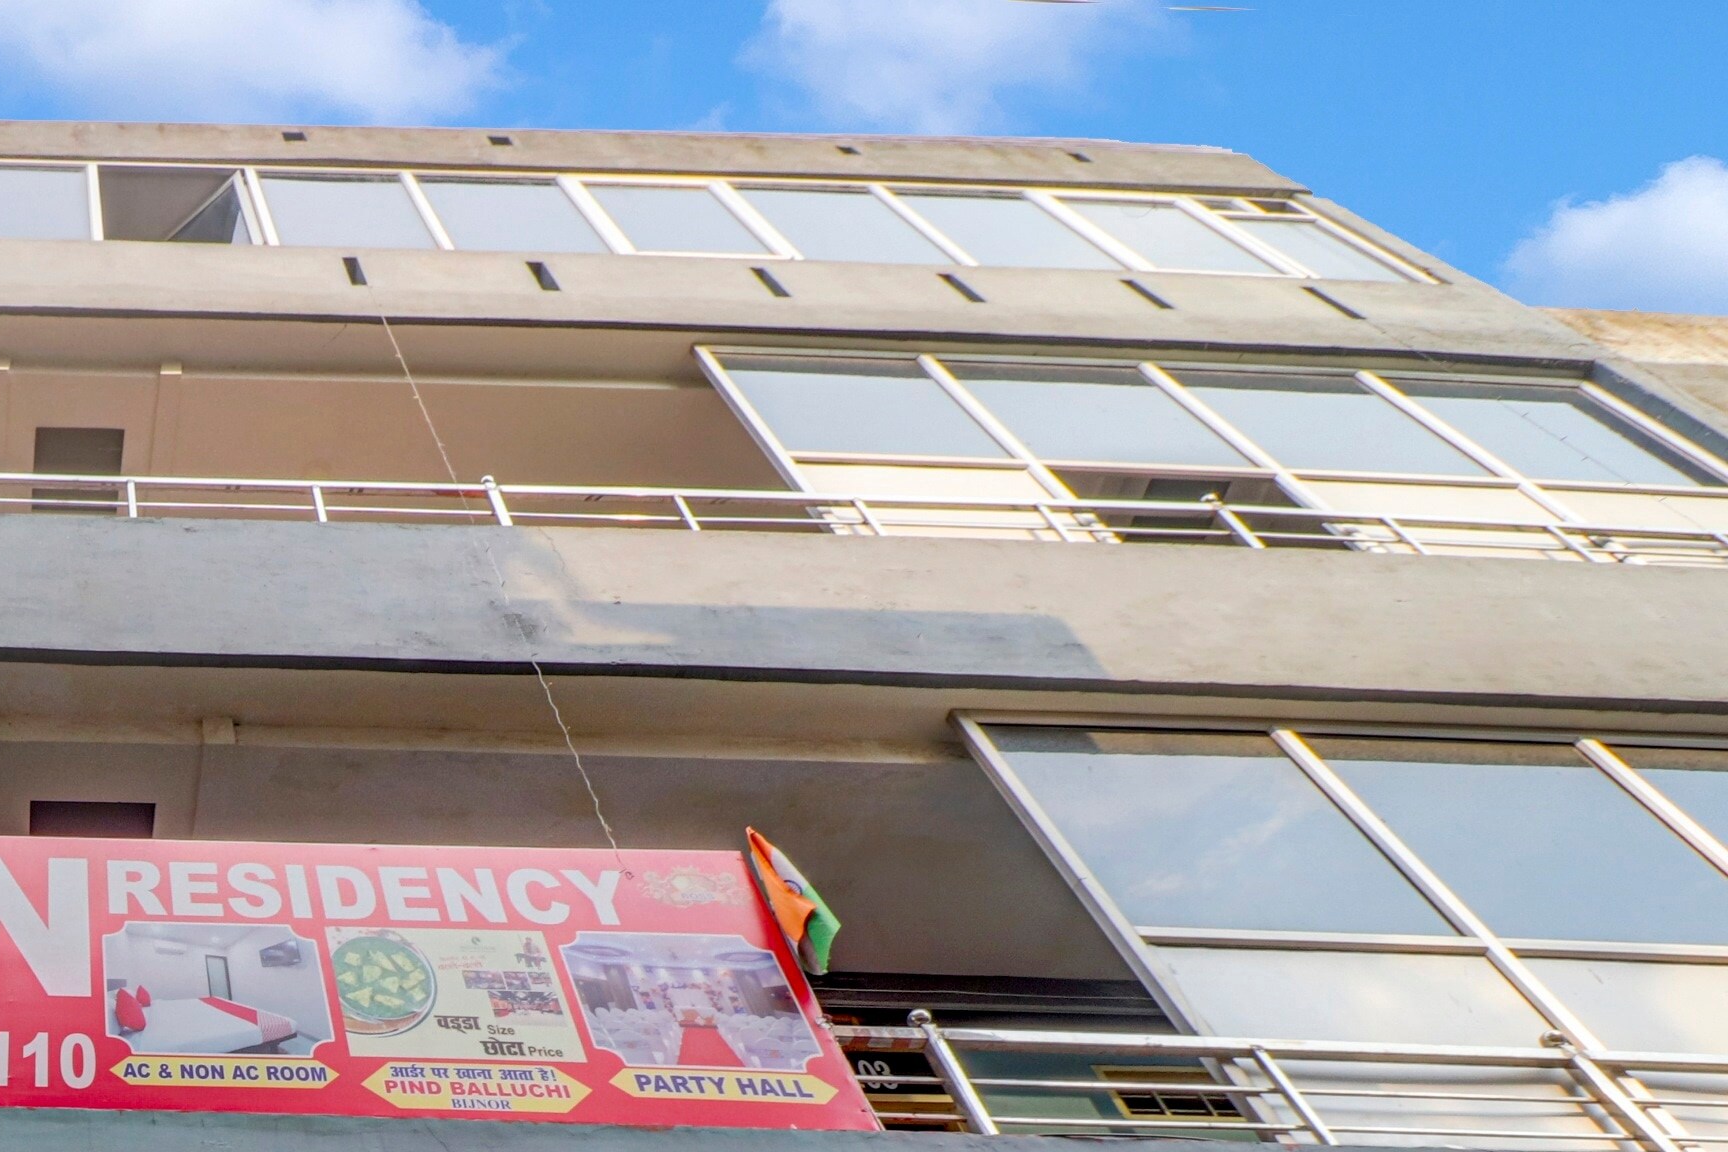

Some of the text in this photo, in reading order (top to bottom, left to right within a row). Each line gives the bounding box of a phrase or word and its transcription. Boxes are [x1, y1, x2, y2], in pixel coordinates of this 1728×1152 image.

[106, 858, 622, 926] RESIDENCY
[487, 1024, 515, 1036] Size
[528, 1046, 564, 1058] Price
[123, 1062, 328, 1083] AC & NON AC ROOM
[430, 1067, 449, 1080] पर
[453, 1067, 492, 1081] खाना
[499, 1069, 534, 1082] आता
[384, 1080, 572, 1098] PIND BALLUCHI
[634, 1073, 815, 1099] PARTY HALL
[451, 1098, 513, 1111] BIJNOR
